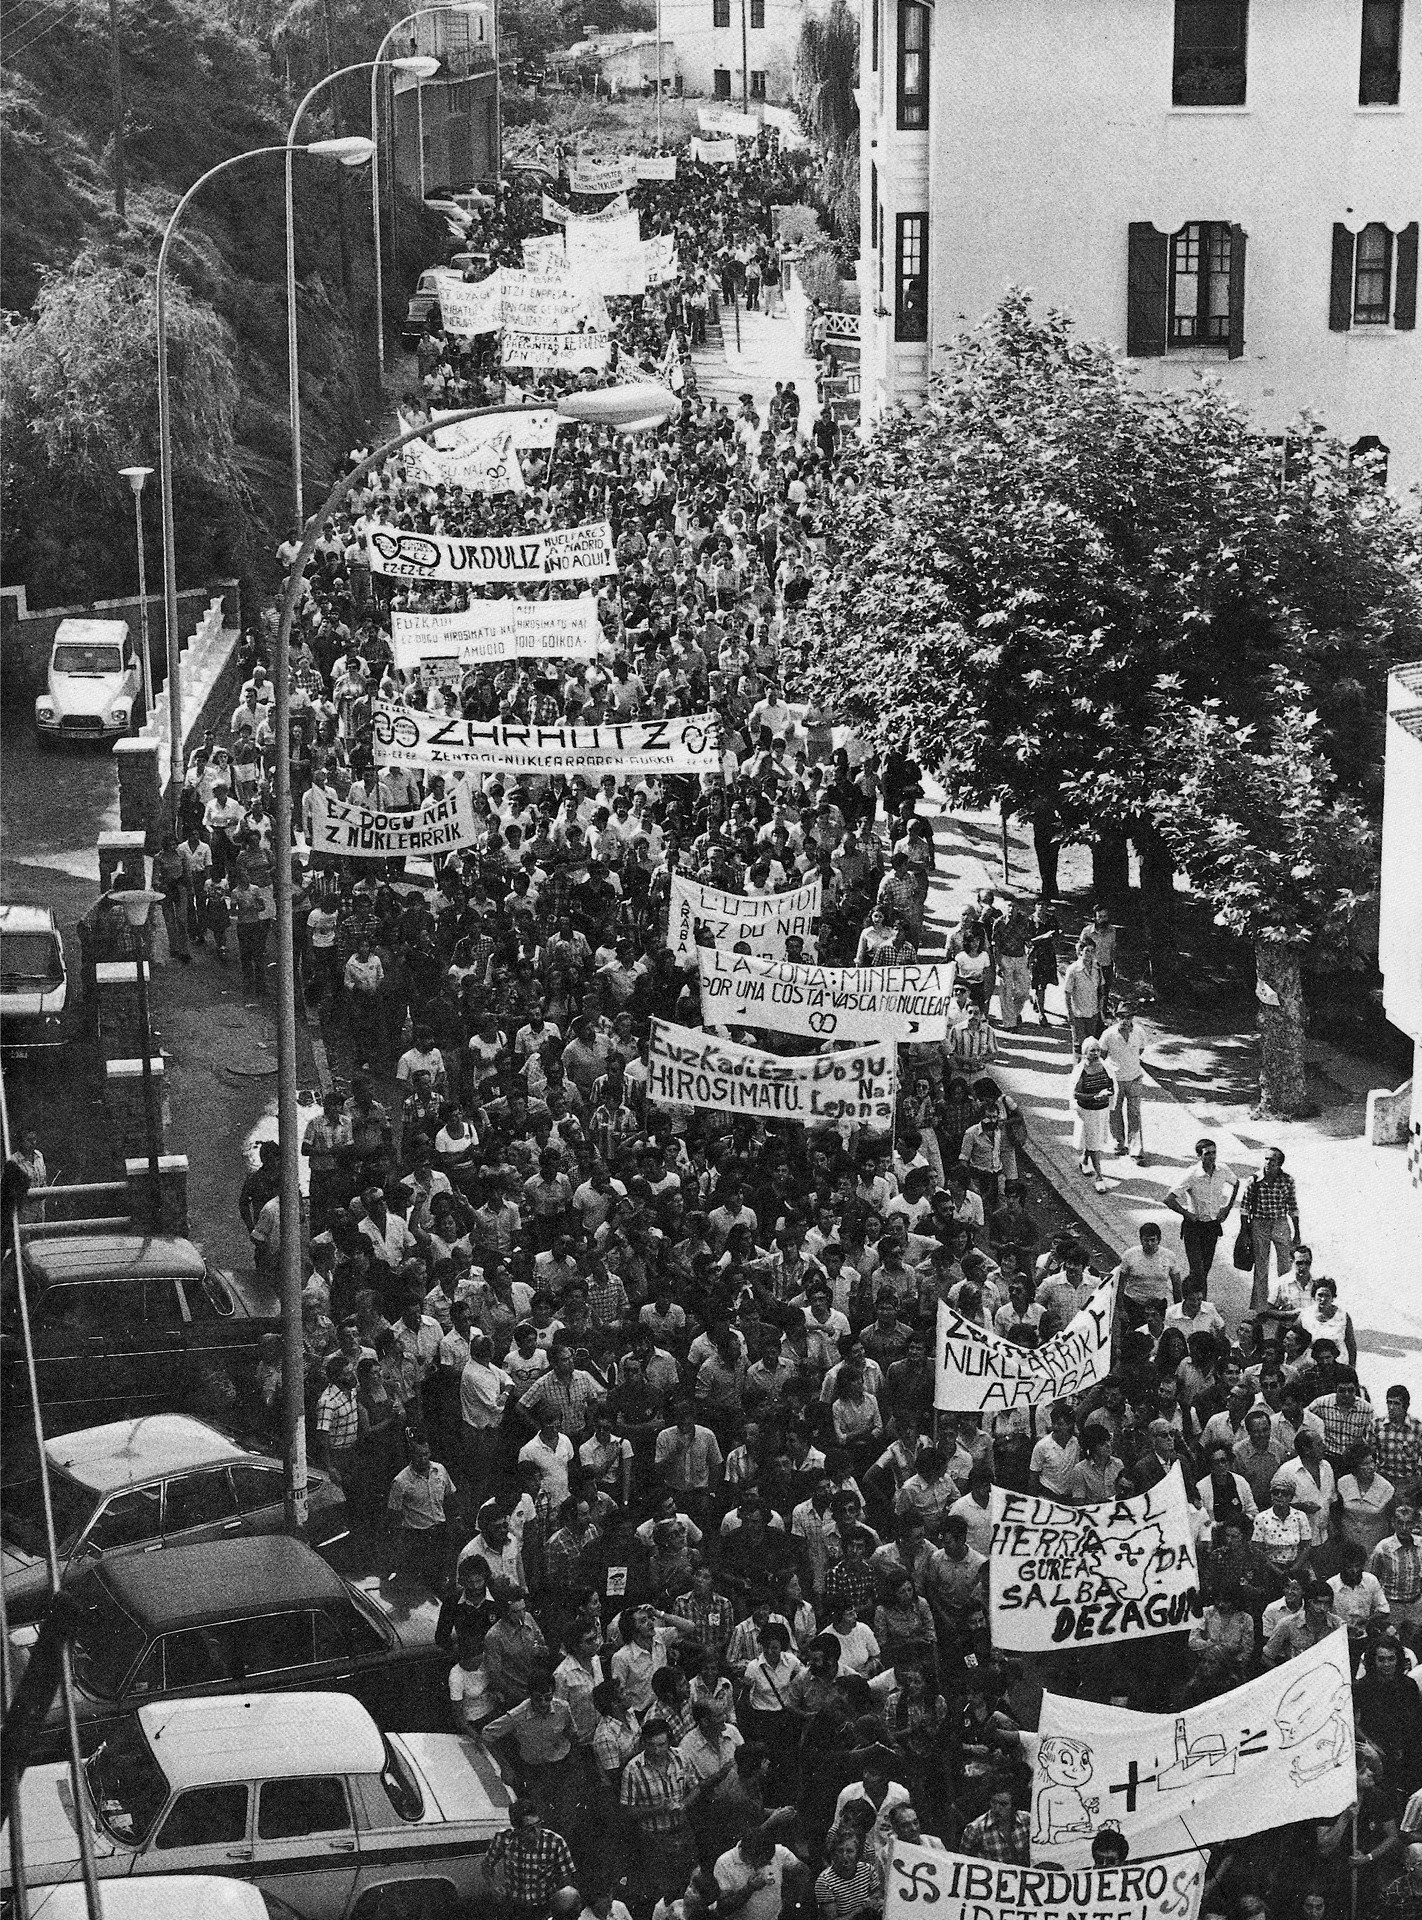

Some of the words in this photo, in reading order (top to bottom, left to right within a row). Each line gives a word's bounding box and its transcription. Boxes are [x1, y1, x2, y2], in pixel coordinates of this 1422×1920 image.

[448, 543, 540, 570] URDULIZ
[564, 538, 604, 553] MADRID
[360, 811, 415, 831] DOGU
[423, 795, 458, 826] NAI
[677, 899, 690, 953] ARABA
[739, 923, 766, 939] DU
[777, 916, 812, 936] NAI
[715, 951, 751, 974] LA
[841, 965, 941, 993] MINERA
[736, 981, 765, 1001] UNA
[978, 1358, 1097, 1410] ARABA
[990, 1523, 1106, 1558] HERRIA
[1018, 1557, 1091, 1582] GUREA
[1155, 1544, 1195, 1574] DA
[999, 1579, 1120, 1610] SALBA
[1051, 1586, 1204, 1643] DEZAGUN
[947, 1862, 1168, 1907] IBERDUERO
